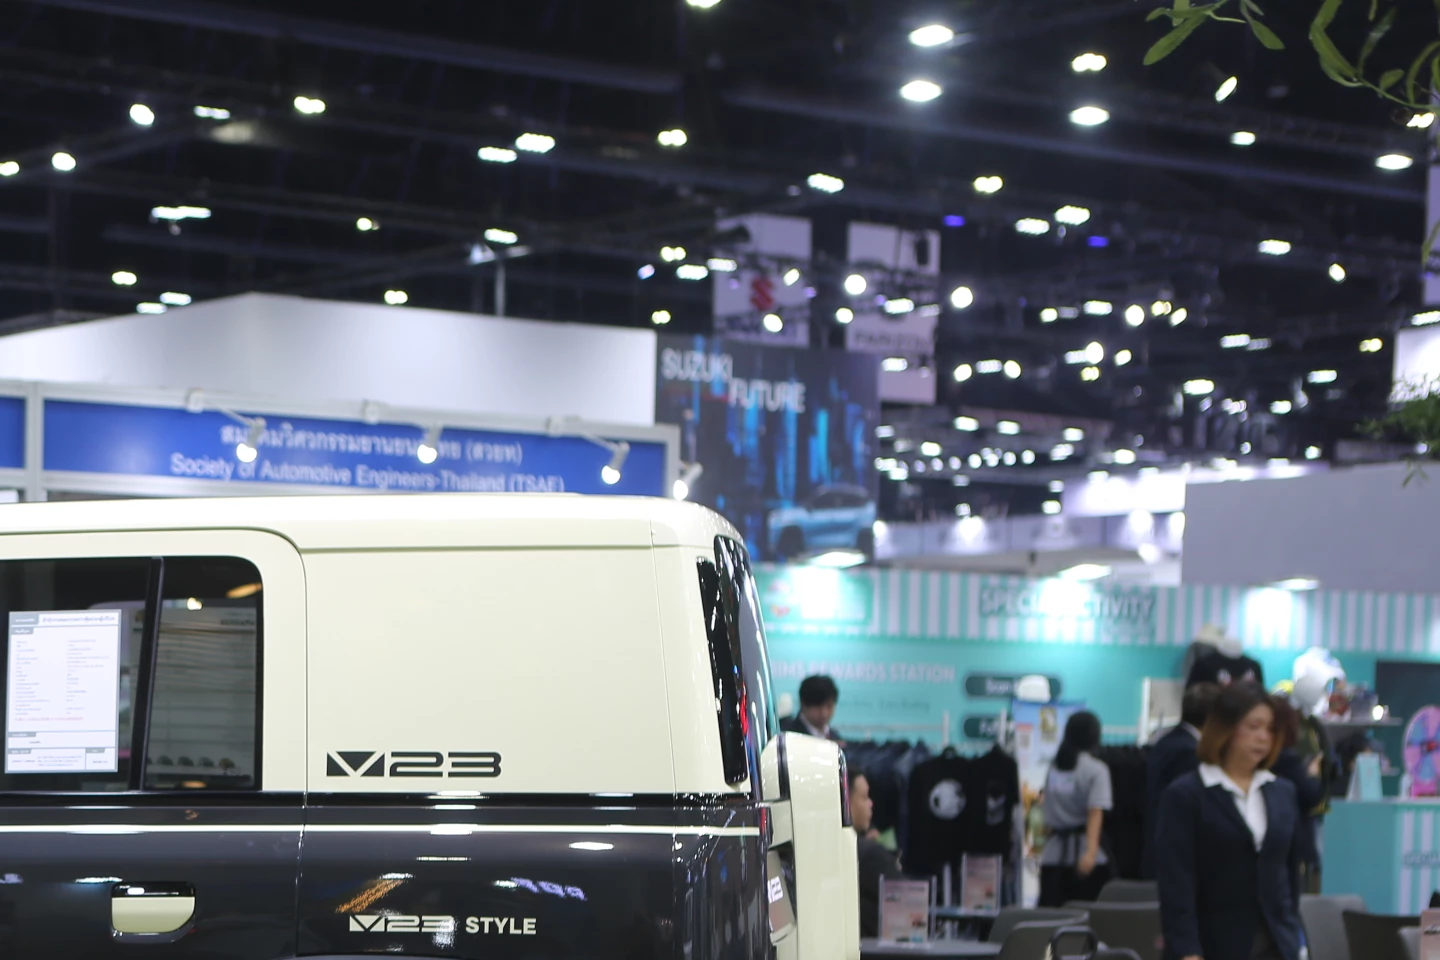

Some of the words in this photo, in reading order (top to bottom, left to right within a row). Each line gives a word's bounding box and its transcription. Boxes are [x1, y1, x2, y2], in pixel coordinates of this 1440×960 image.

[661, 348, 733, 382] SUZUKI
[326, 751, 502, 777] V23
[349, 915, 455, 933] V23
[465, 917, 537, 935] STYLE
